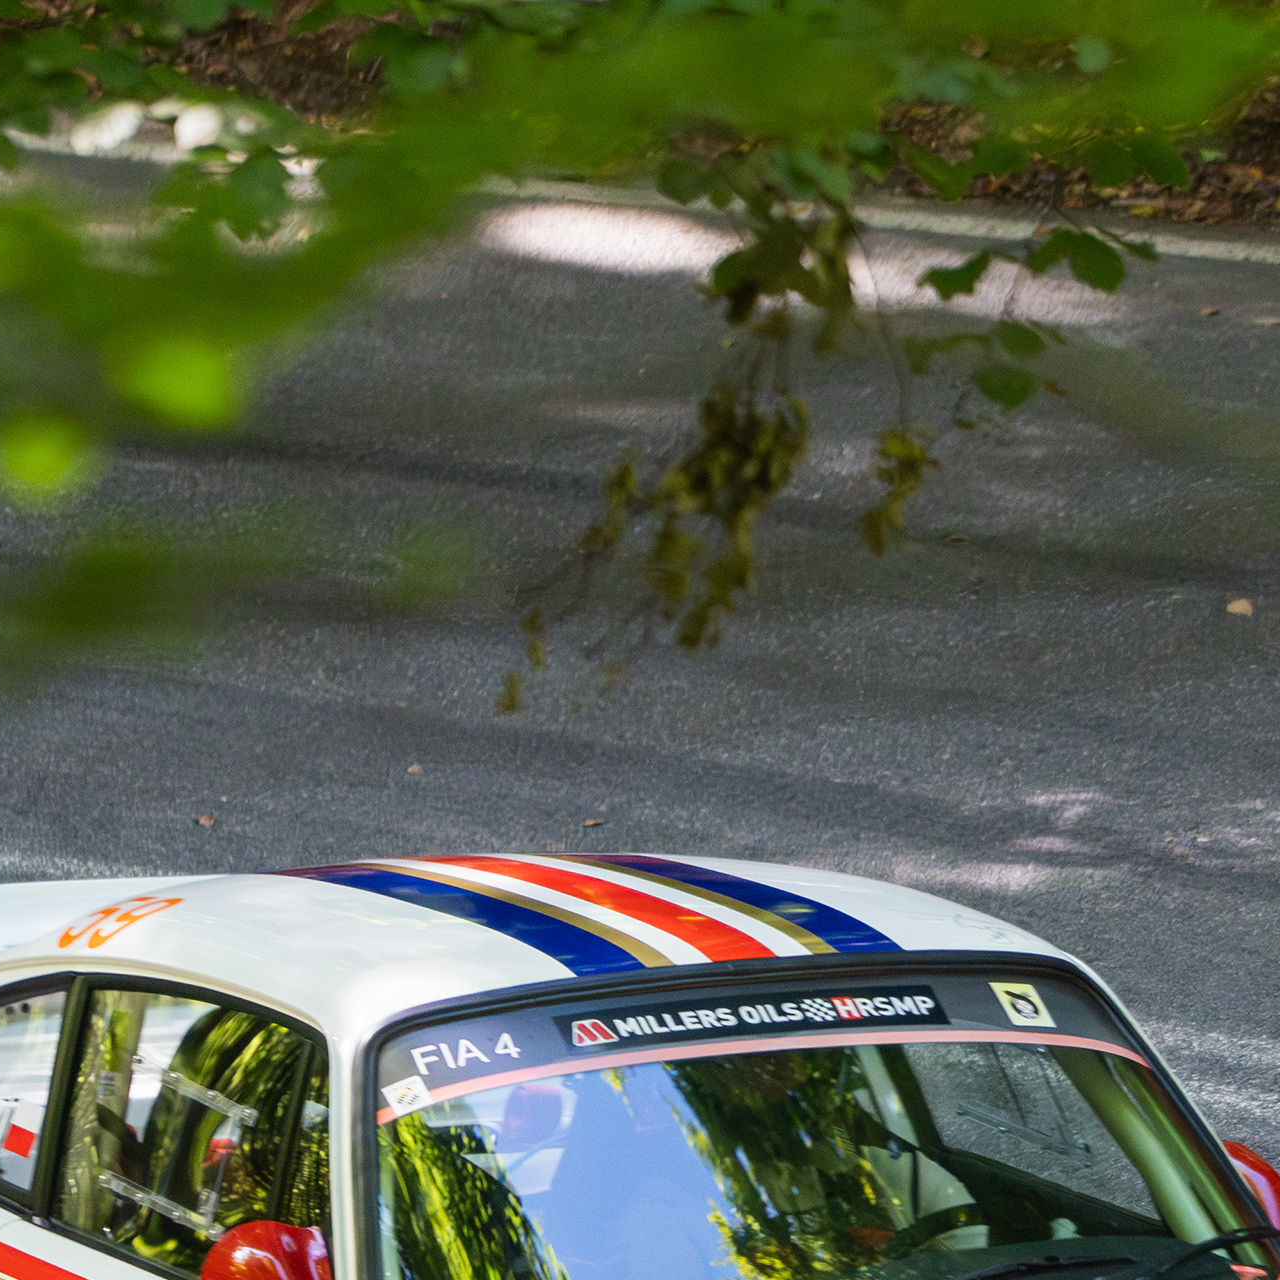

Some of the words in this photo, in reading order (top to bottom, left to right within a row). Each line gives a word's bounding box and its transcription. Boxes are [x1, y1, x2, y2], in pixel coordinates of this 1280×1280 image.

[612, 1007, 738, 1037] MILLERS
[738, 1002, 805, 1024] OILS
[831, 995, 936, 1020] HRSMP
[410, 1038, 491, 1075] FIA
[494, 1032, 521, 1059] 4
